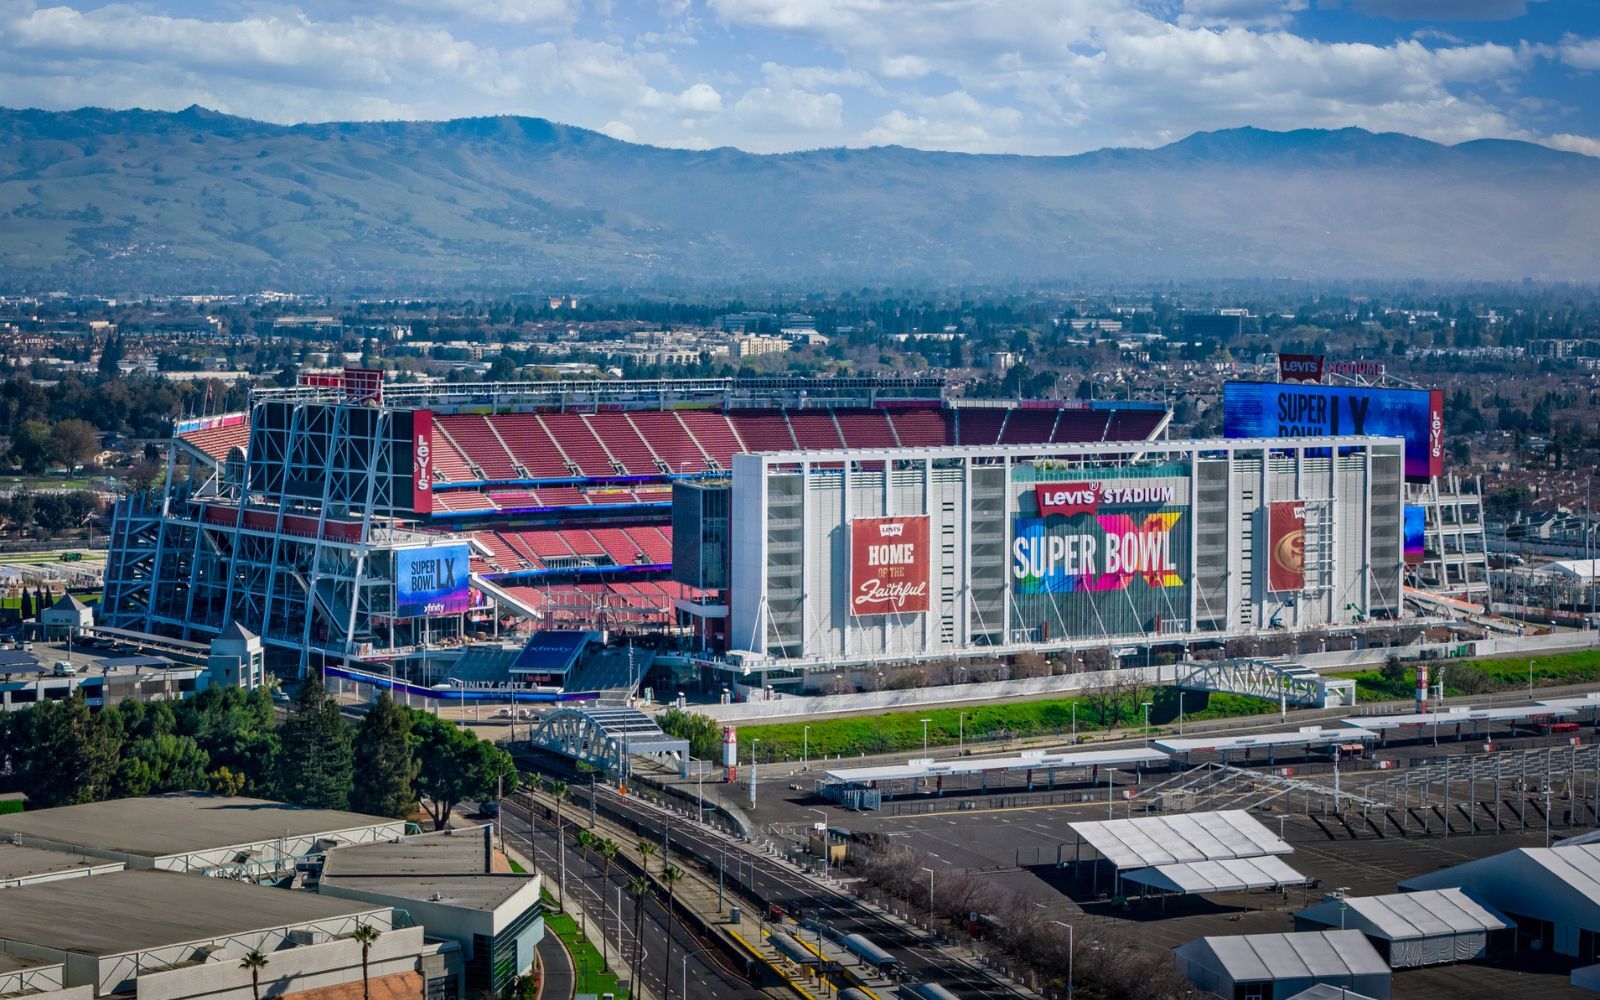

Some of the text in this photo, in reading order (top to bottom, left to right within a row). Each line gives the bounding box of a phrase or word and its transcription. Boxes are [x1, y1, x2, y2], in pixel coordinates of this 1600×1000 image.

[1278, 392, 1327, 425] SUPER
[1103, 487, 1175, 504] STADIUM
[868, 543, 914, 566] HOME
[1013, 530, 1176, 579] SUPER BOWL
[411, 559, 435, 575] SUPER
[436, 558, 456, 589] LX
[878, 566, 905, 578] OF THE
[411, 575, 435, 592] BOWL
[855, 579, 926, 607] Faithful
[498, 681, 526, 690] GATE
[729, 732, 736, 742] A
